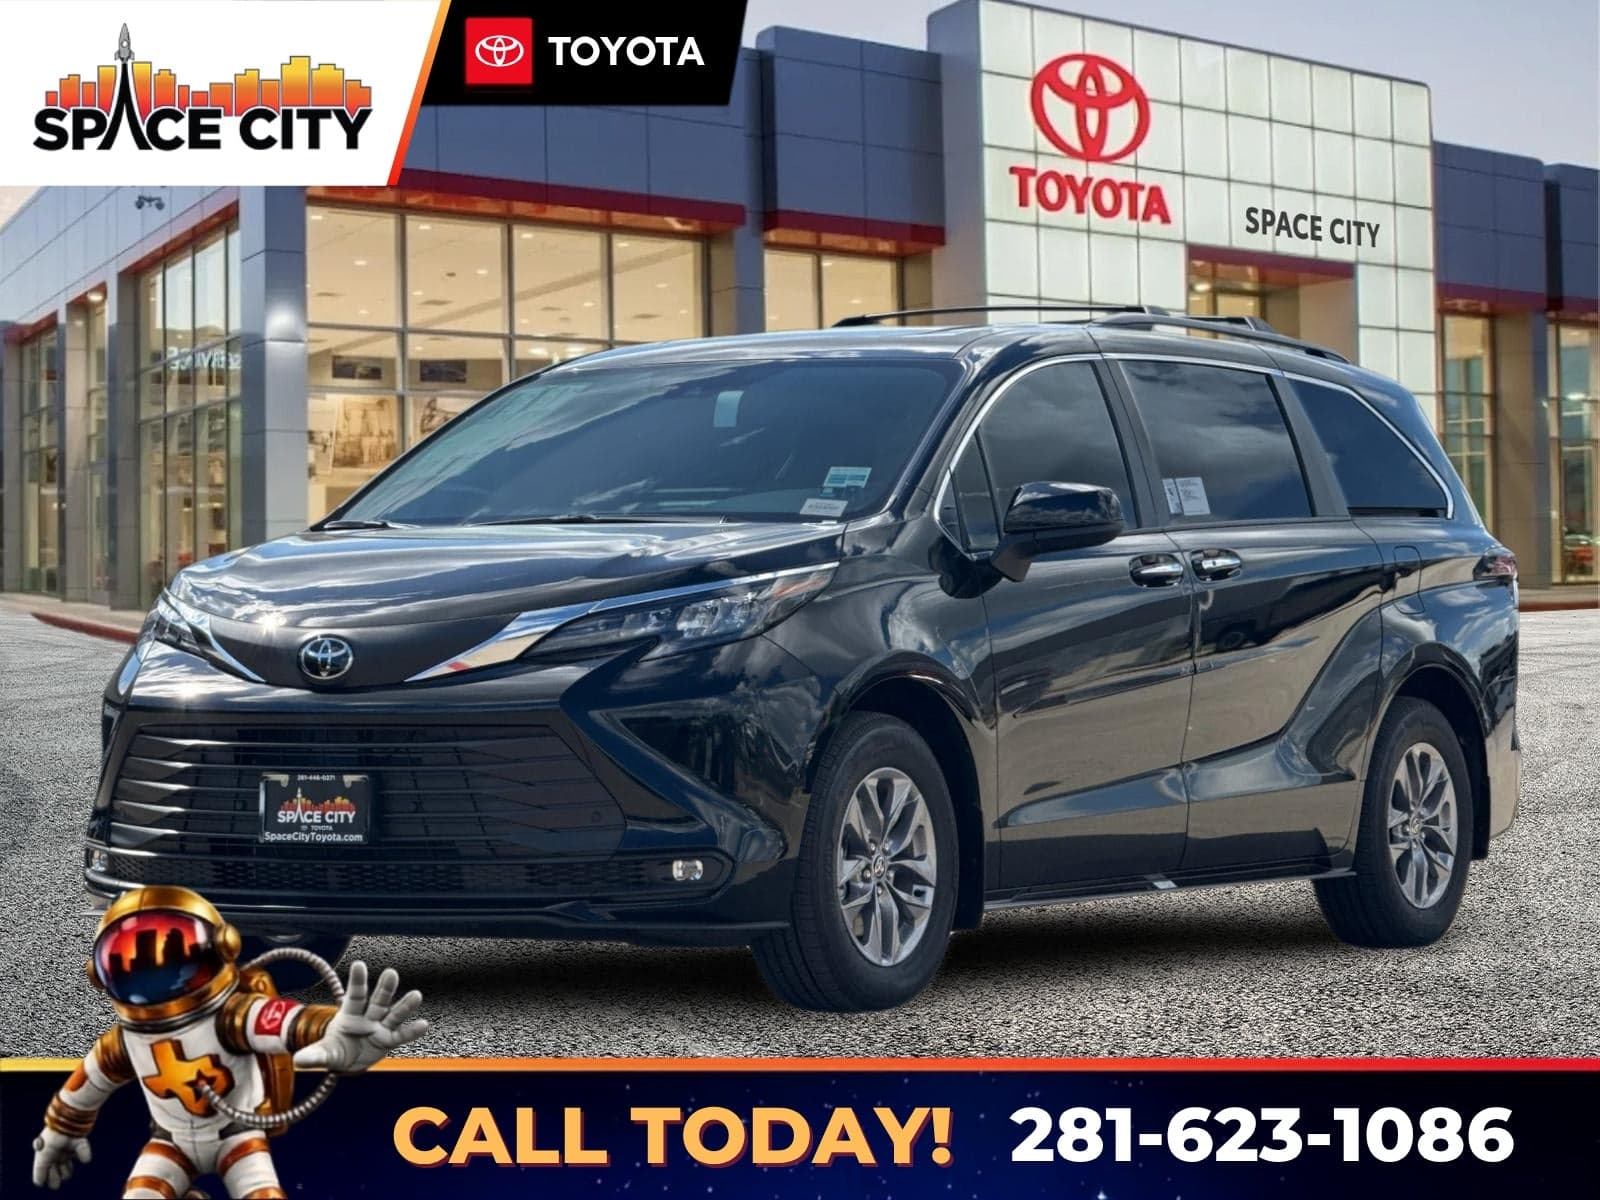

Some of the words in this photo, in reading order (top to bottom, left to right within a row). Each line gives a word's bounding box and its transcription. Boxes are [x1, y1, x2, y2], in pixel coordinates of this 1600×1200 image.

[1009, 165, 1172, 225] TOYOTA
[1245, 206, 1323, 241] SPACE
[1329, 218, 1381, 248] CITY
[277, 810, 321, 823] SPACE
[325, 810, 356, 823] CITY
[264, 832, 363, 842] SpaceCityToyota.com
